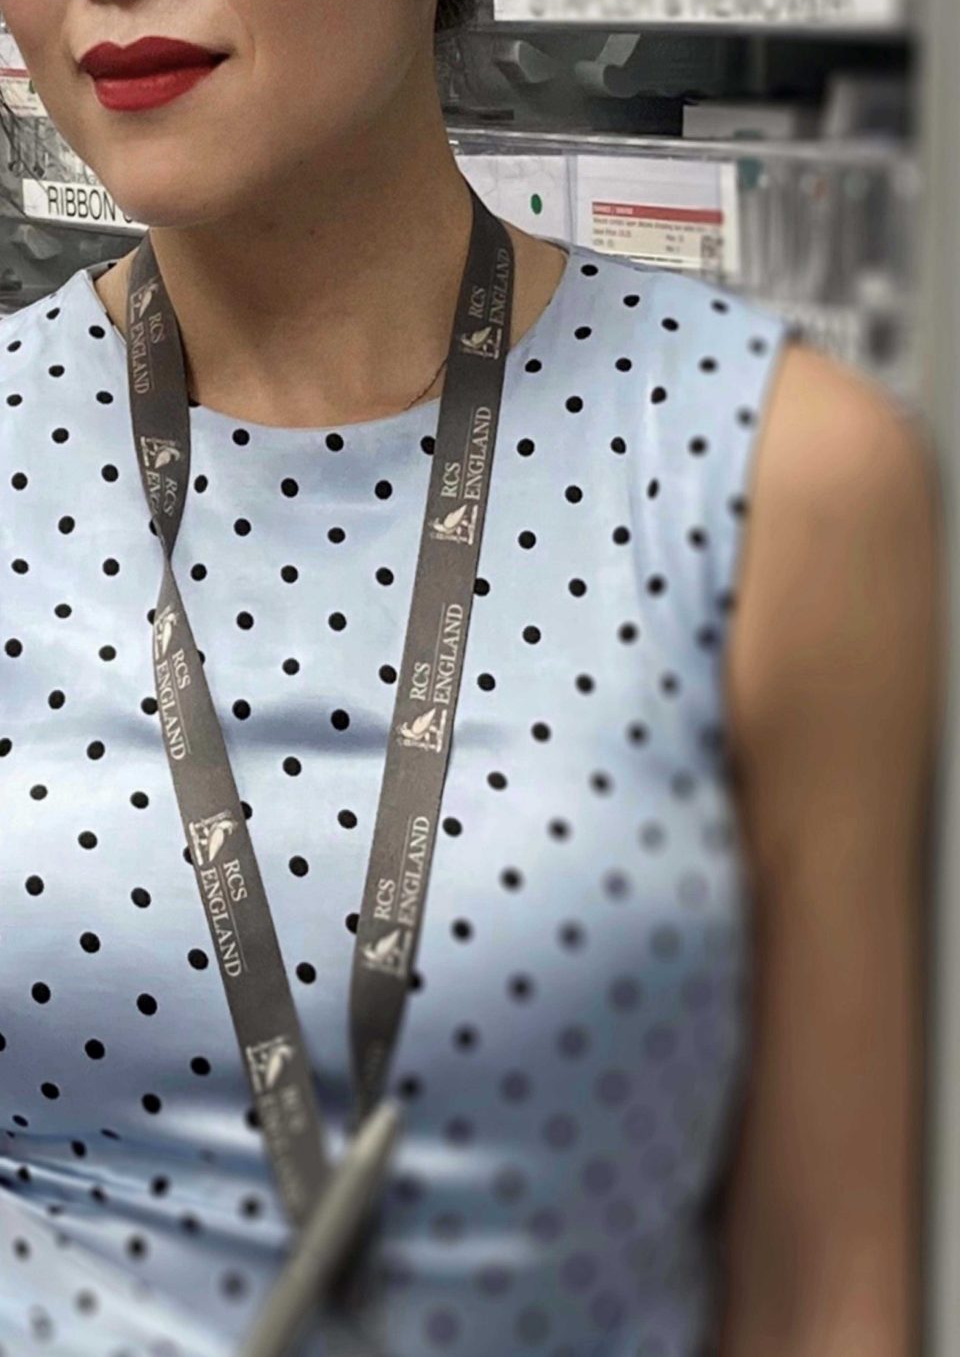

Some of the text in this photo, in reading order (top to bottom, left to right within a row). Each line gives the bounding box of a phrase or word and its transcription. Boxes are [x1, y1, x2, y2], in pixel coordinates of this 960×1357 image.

[47, 185, 116, 222] RIBBON
[468, 285, 486, 319] RCS
[488, 248, 510, 326] ENGLAND
[148, 311, 165, 344] RCS
[130, 321, 150, 395] ENGLAND
[463, 406, 492, 501] ENGLAND
[164, 476, 178, 518] RCS
[441, 462, 461, 498] RCS
[171, 648, 192, 691] RCS
[433, 603, 464, 705] ENGLAND
[409, 662, 431, 702] RCS
[156, 660, 187, 761] ENGLAND
[223, 858, 248, 902] RCS
[397, 815, 430, 927] ENGLAND
[373, 878, 396, 921] RCS
[200, 866, 242, 977] ENGLAND
